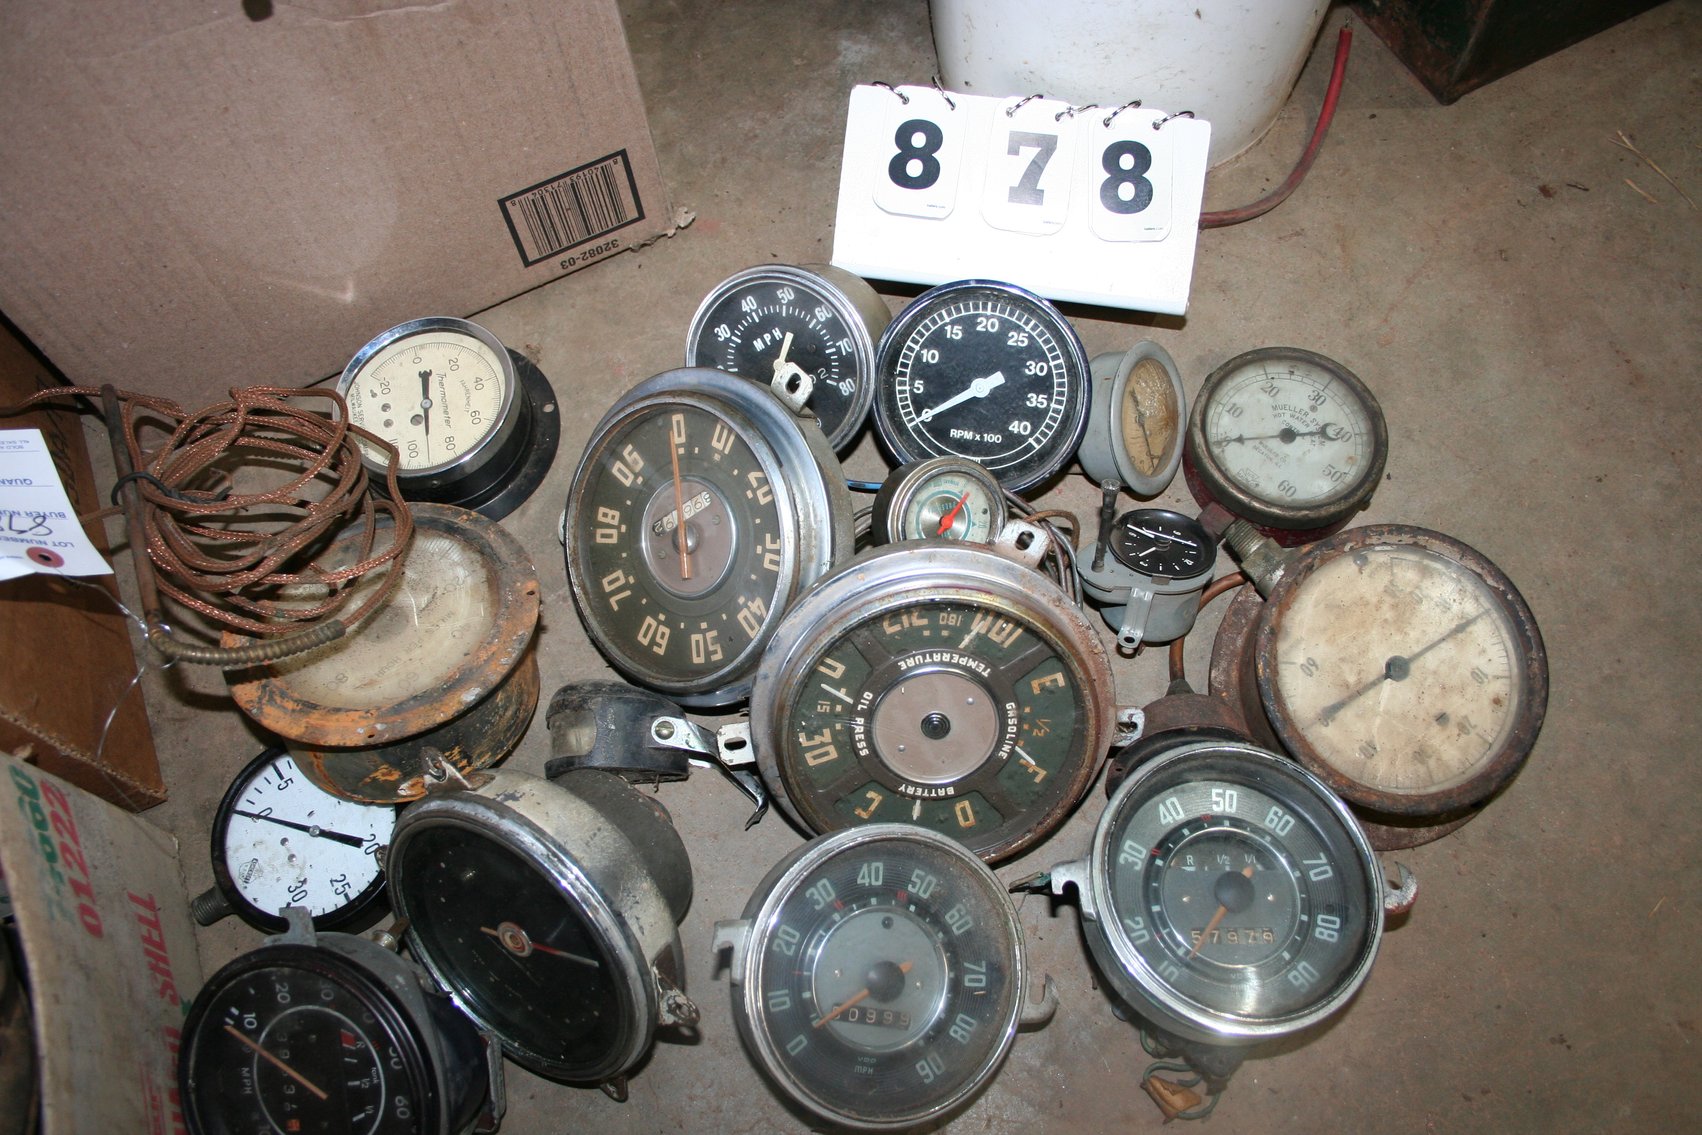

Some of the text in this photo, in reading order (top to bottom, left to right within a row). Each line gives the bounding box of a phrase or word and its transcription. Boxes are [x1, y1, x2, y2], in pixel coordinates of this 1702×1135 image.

[888, 118, 1154, 215] 8 7 8
[560, 238, 620, 270] 32082-03
[740, 295, 758, 312] 40
[776, 287, 795, 304] 50
[814, 305, 833, 322] 60
[976, 317, 999, 332] 20
[713, 323, 731, 342] 30
[944, 324, 963, 340] 15
[1007, 331, 1029, 347] 25
[835, 337, 853, 356] 70
[920, 349, 939, 364] 10
[412, 356, 422, 365] 0
[448, 357, 460, 372] 20
[1024, 360, 1048, 376] 30
[380, 376, 391, 395] -20
[474, 377, 485, 391] 40
[838, 379, 856, 396] 80
[912, 380, 924, 394] 5
[1259, 380, 1280, 398] 20
[436, 372, 452, 429] Thermometer
[1025, 393, 1048, 408] 35
[1307, 389, 1327, 407] 30
[470, 410, 481, 425] 60
[1225, 402, 1244, 419] 10
[1271, 403, 1310, 418] MUELLER
[1289, 414, 1310, 428] WATER
[671, 413, 686, 444] 0
[949, 428, 973, 440] RPM
[982, 433, 1002, 443] 100
[1008, 420, 1031, 436] 40
[1332, 423, 1353, 444] 40
[407, 440, 419, 459] 100
[444, 435, 456, 451] 80
[611, 443, 645, 487] 90
[1321, 462, 1344, 484] 50
[1277, 478, 1297, 498] 60
[24, 510, 67, 519] BUYER
[596, 506, 620, 544] 80
[602, 569, 632, 612] 70
[737, 597, 768, 640] 40
[938, 612, 963, 628] 180
[637, 615, 671, 656] 60
[690, 629, 724, 664] 50
[897, 651, 992, 678] TEMPERATURE
[326, 672, 348, 691] 80
[1030, 671, 1065, 695] E
[816, 700, 831, 713] 15
[854, 691, 874, 757] OIL PRESS
[997, 702, 1018, 760] GASOLINE
[799, 728, 839, 767] 30
[1019, 758, 1048, 784] F
[277, 777, 295, 791] 5
[898, 782, 955, 797] BATTERY
[854, 790, 883, 820] C
[1158, 796, 1185, 826] 40
[1211, 788, 1238, 813] 50
[1263, 805, 1295, 837] 60
[362, 833, 382, 856] 20
[1119, 839, 1148, 871] 30
[40, 779, 104, 938] 01222
[1186, 854, 1194, 866] R
[1302, 852, 1333, 882] 70
[330, 873, 352, 896] 25
[856, 861, 884, 887] 40
[907, 869, 937, 900] 50
[287, 878, 309, 903] 30
[805, 878, 836, 910] 30
[944, 904, 974, 936] 60
[1123, 916, 1150, 945] 20
[1314, 913, 1341, 943] 80
[127, 890, 179, 1007] SHELL
[772, 924, 801, 957] 20
[963, 960, 986, 988] 70
[1287, 960, 1320, 992] 90
[275, 982, 291, 1004] 20
[768, 989, 791, 1013] 10
[242, 1012, 258, 1030] 10
[950, 1013, 978, 1045] 80
[786, 1034, 808, 1057] 0
[370, 1066, 379, 1084] tank
[853, 1065, 874, 1075] MPH
[915, 1050, 946, 1084] 90
[241, 1066, 253, 1095] MPH
[394, 1095, 411, 1120] 60
